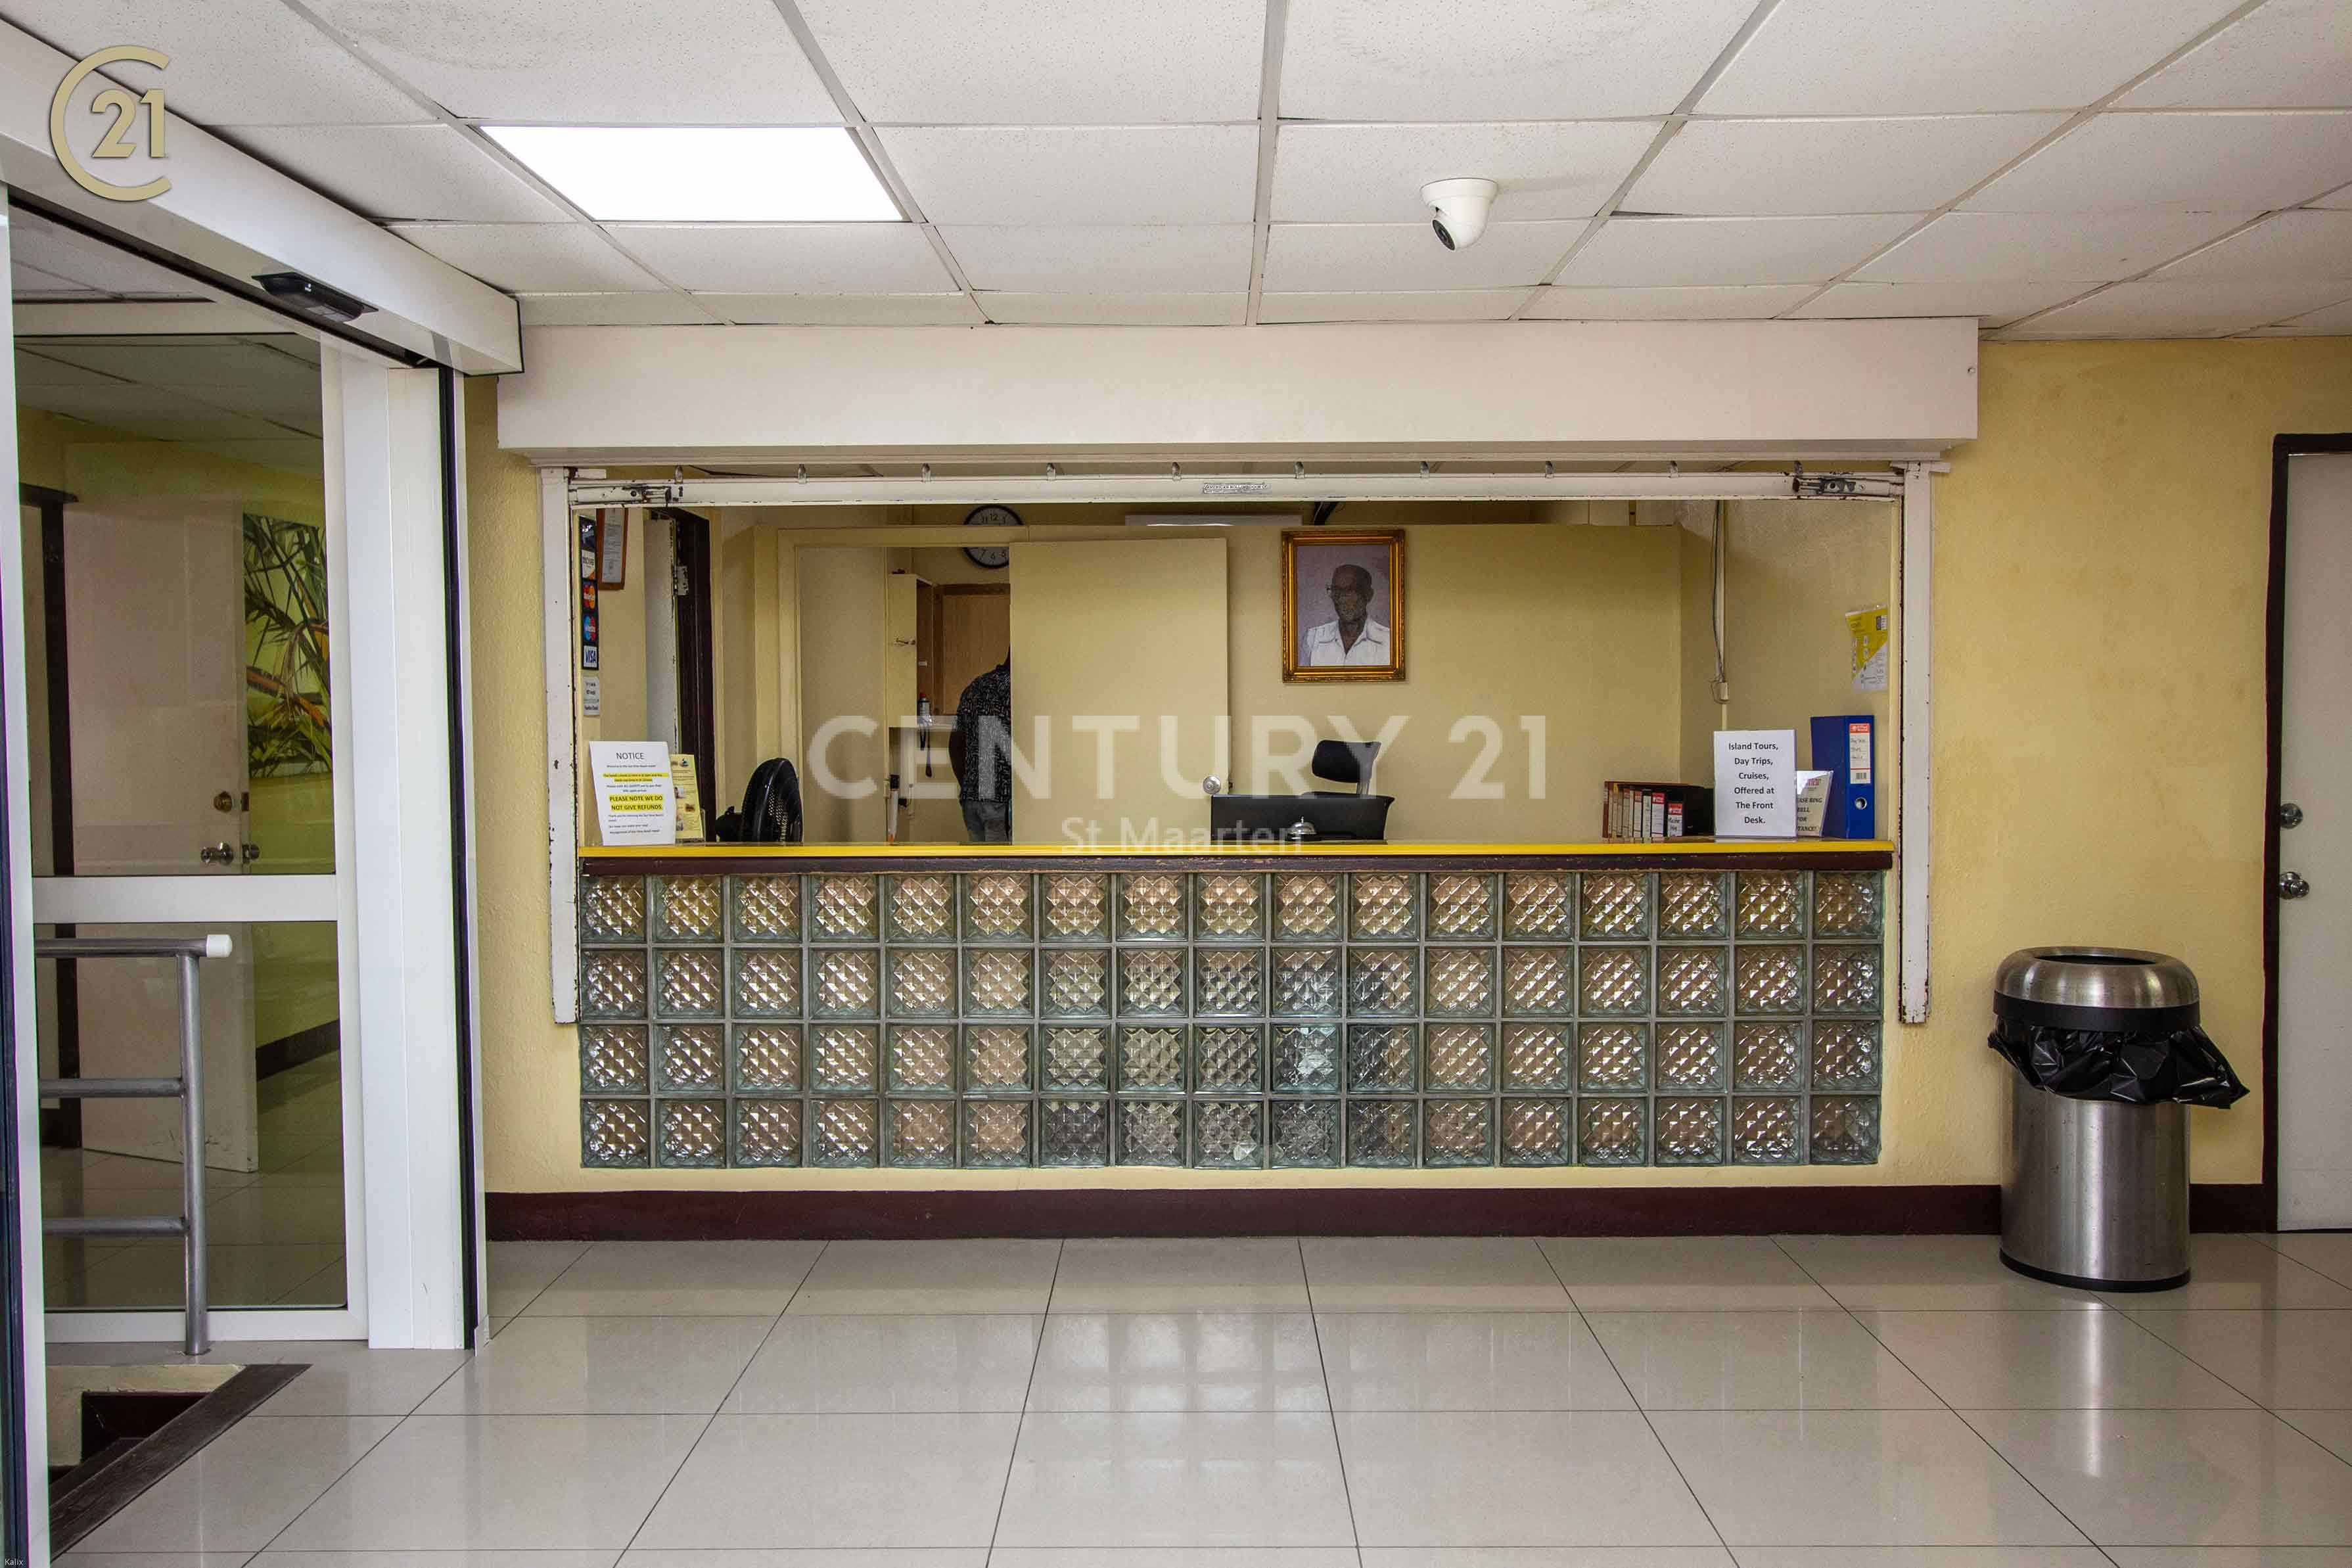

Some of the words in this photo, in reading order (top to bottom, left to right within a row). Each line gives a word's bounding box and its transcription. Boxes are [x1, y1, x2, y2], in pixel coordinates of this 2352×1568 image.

[586, 649, 596, 663] VISA
[1754, 742, 1778, 750] Tours,
[1734, 757, 1749, 766] Day
[1751, 757, 1773, 766] Trips,
[1734, 786, 1764, 795] Offered
[1744, 816, 1766, 824] Desk.
